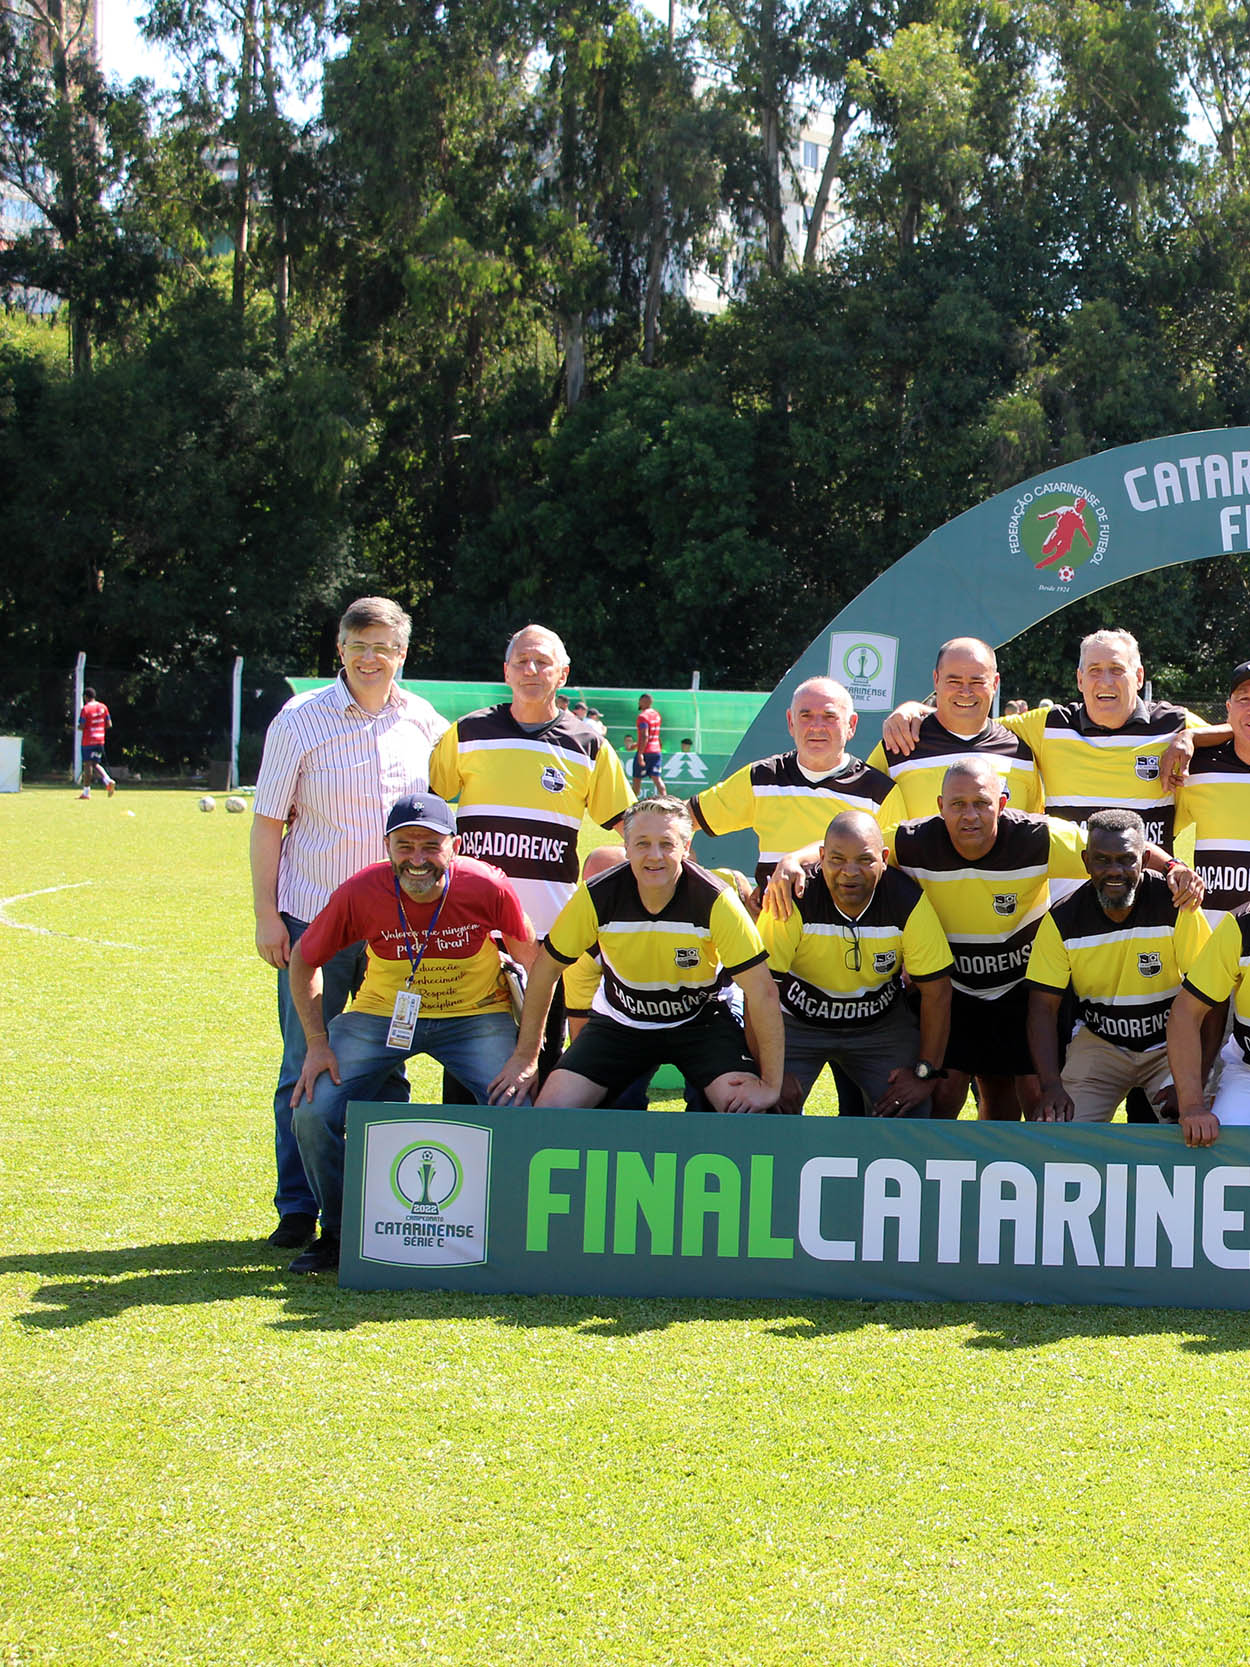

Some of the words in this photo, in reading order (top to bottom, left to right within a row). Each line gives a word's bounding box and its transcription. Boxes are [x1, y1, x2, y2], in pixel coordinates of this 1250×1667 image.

[1034, 482, 1100, 507] CATARINENSE
[1008, 493, 1033, 554] FEDERAÇÃO
[1095, 507, 1109, 522] DE
[1090, 524, 1110, 565] FUTEBOL
[461, 831, 569, 864] CAÇADORENSE
[421, 929, 440, 938] qe
[413, 1204, 438, 1214] 2022
[526, 1148, 794, 1259] FINAL
[374, 1221, 475, 1238] CATARINENSE
[437, 1238, 445, 1248] C
